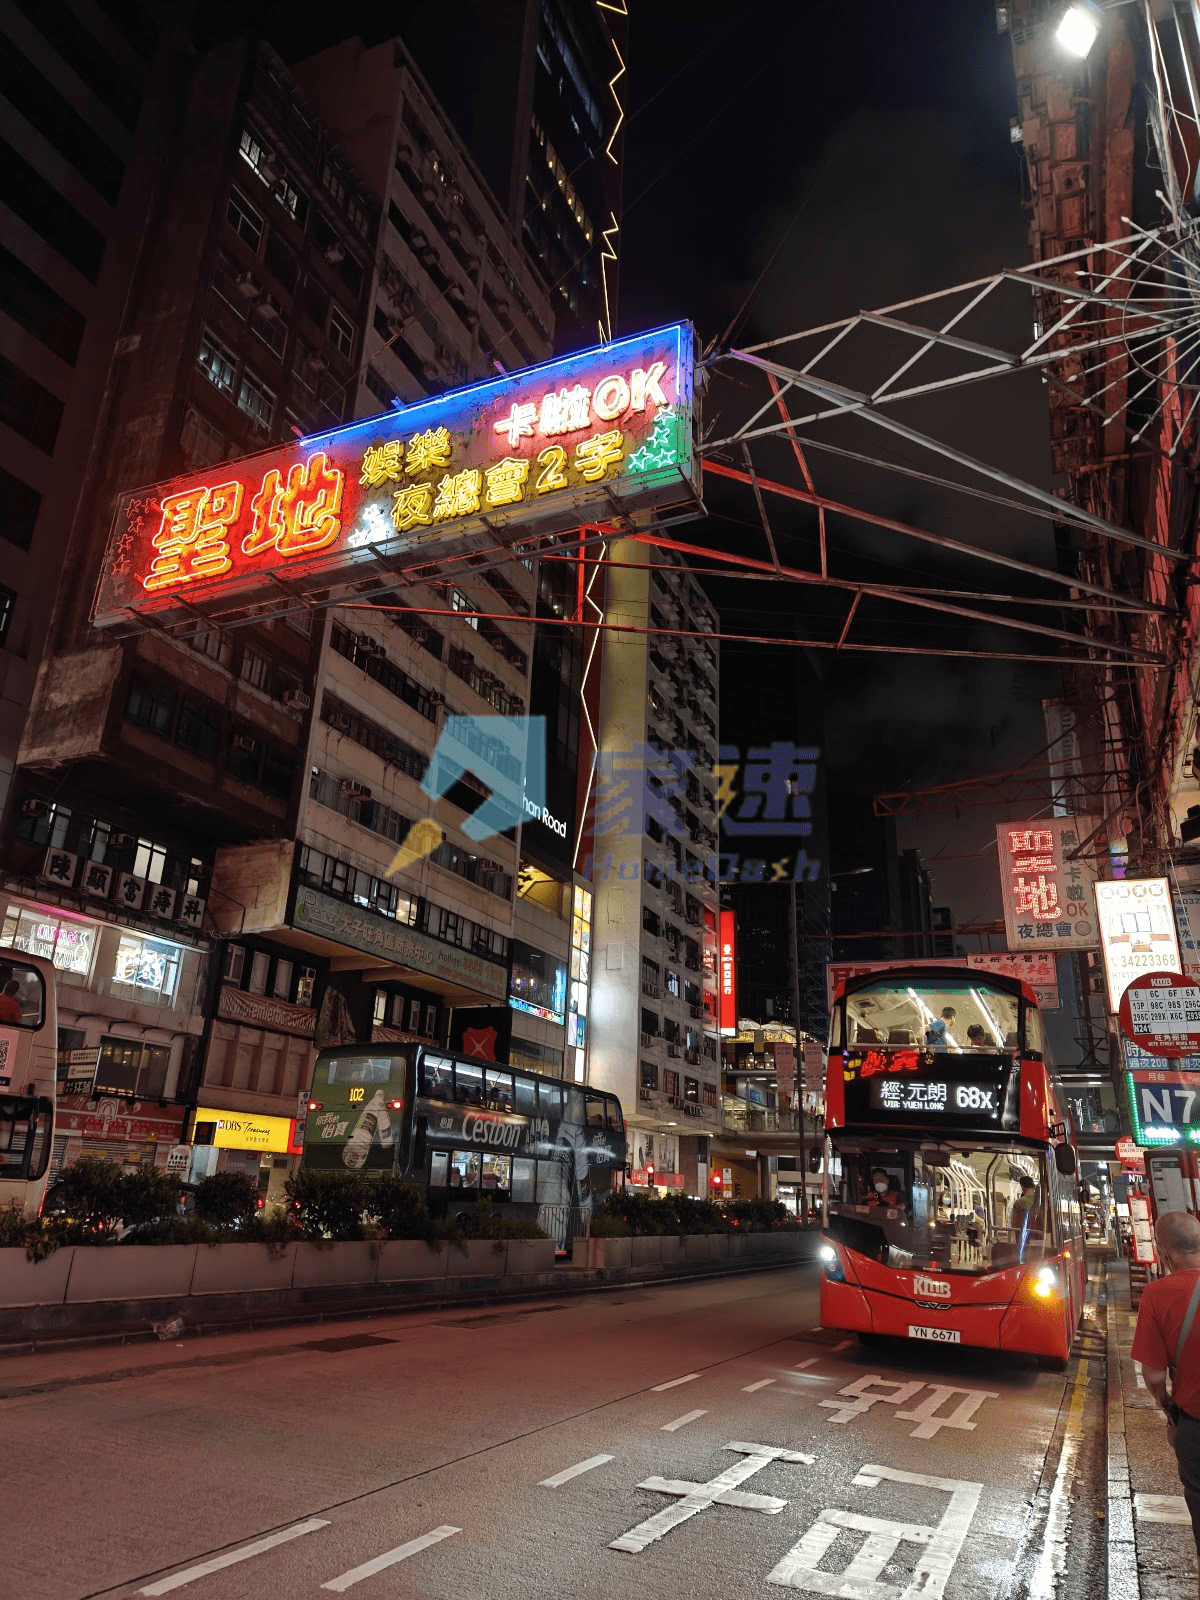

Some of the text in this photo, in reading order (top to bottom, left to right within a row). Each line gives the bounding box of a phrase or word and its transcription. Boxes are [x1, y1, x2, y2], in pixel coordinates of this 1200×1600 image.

[359, 426, 451, 486] 娛樂
[144, 452, 344, 592] 聖地
[542, 806, 567, 839] Road
[1008, 829, 1063, 920] 聖地
[1017, 920, 1072, 939] 夜總會
[1121, 954, 1176, 968] 34223368
[1149, 990, 1159, 998] 6C
[1168, 989, 1177, 997] 6F
[1185, 988, 1196, 997] 6X
[1148, 1072, 1165, 1081] 月台
[349, 1087, 365, 1102] 102
[902, 1101, 923, 1110] YUEN
[925, 1102, 945, 1111] LONG
[225, 1119, 271, 1136] DBS Treasures
[1128, 1173, 1143, 1183] N70
[913, 1327, 957, 1342] YN 6671
